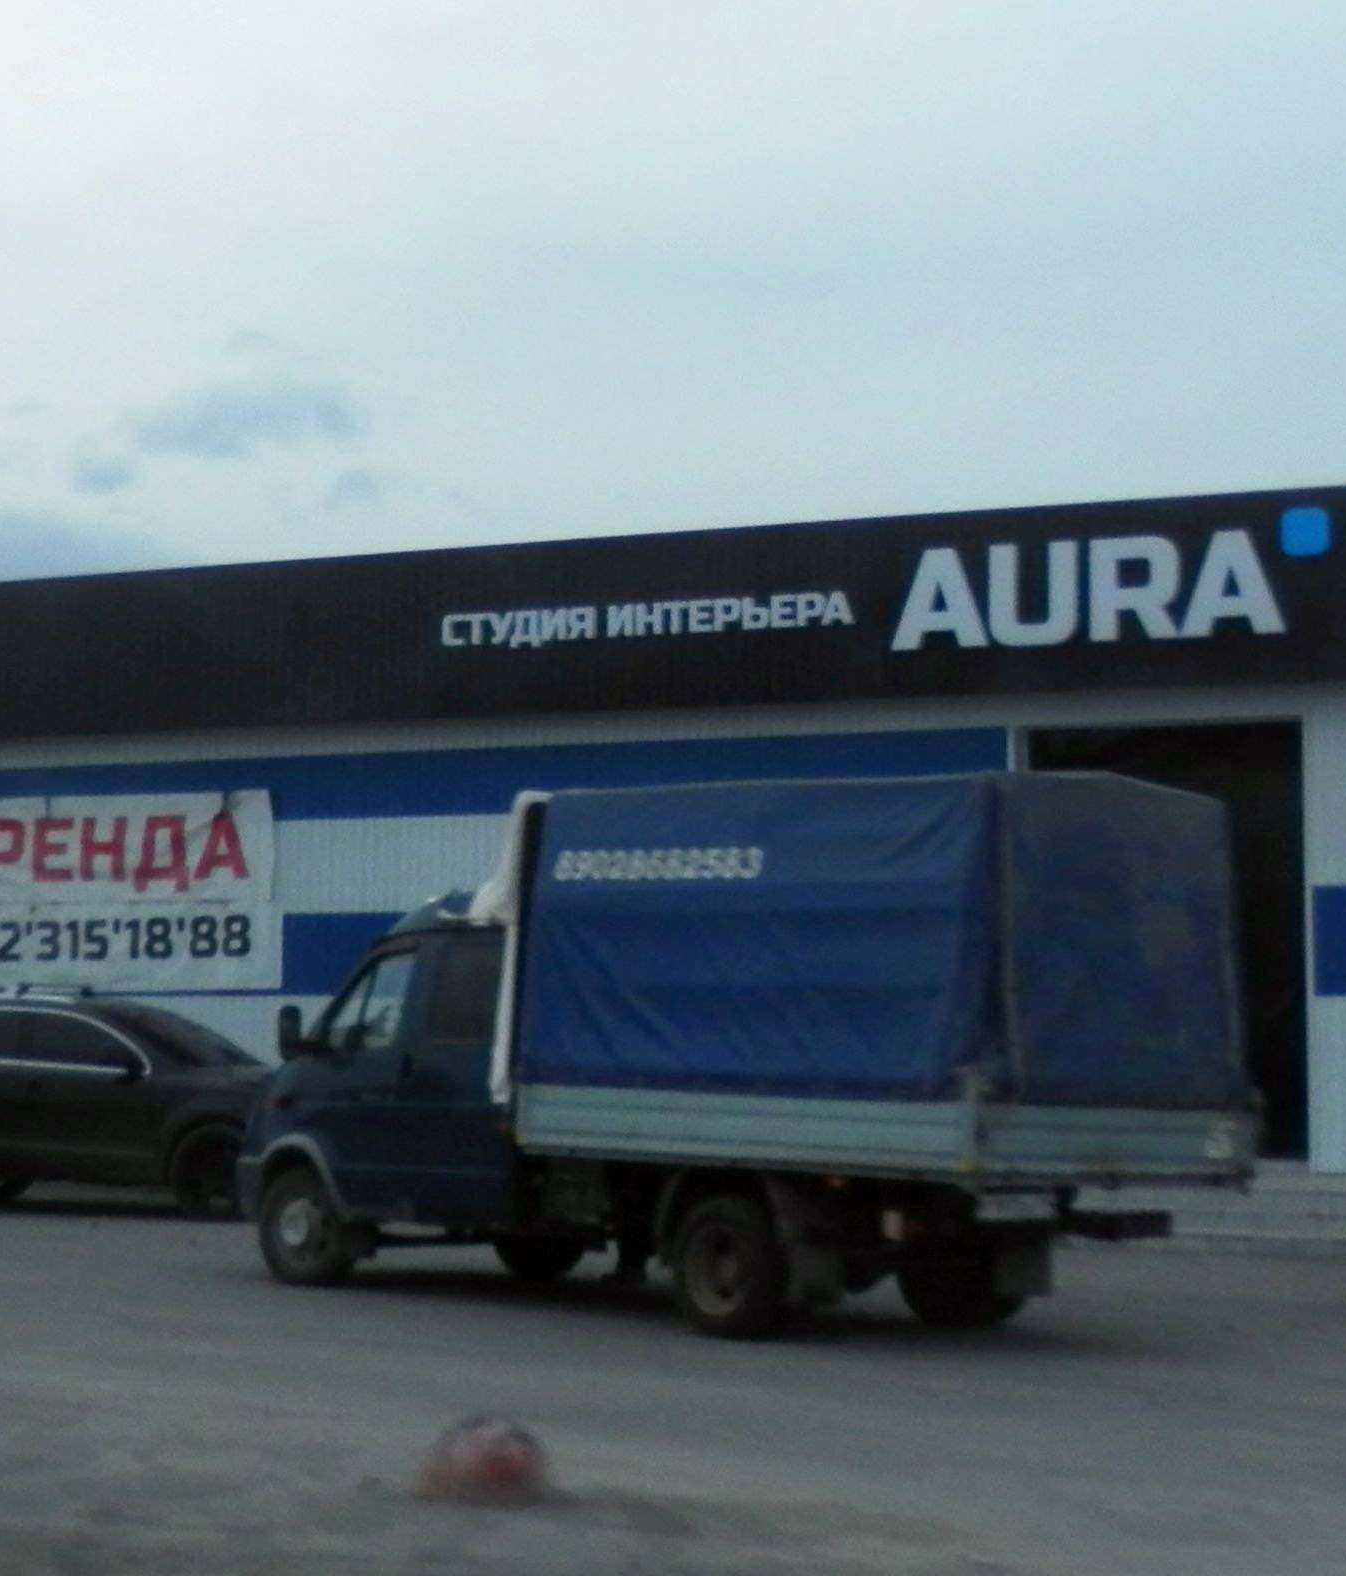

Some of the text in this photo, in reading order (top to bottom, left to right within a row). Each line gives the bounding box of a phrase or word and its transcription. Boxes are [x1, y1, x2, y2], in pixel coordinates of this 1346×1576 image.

[441, 590, 855, 650] СТУДИЯ ИНТЕРЬЕРА
[891, 529, 1287, 652] AURA
